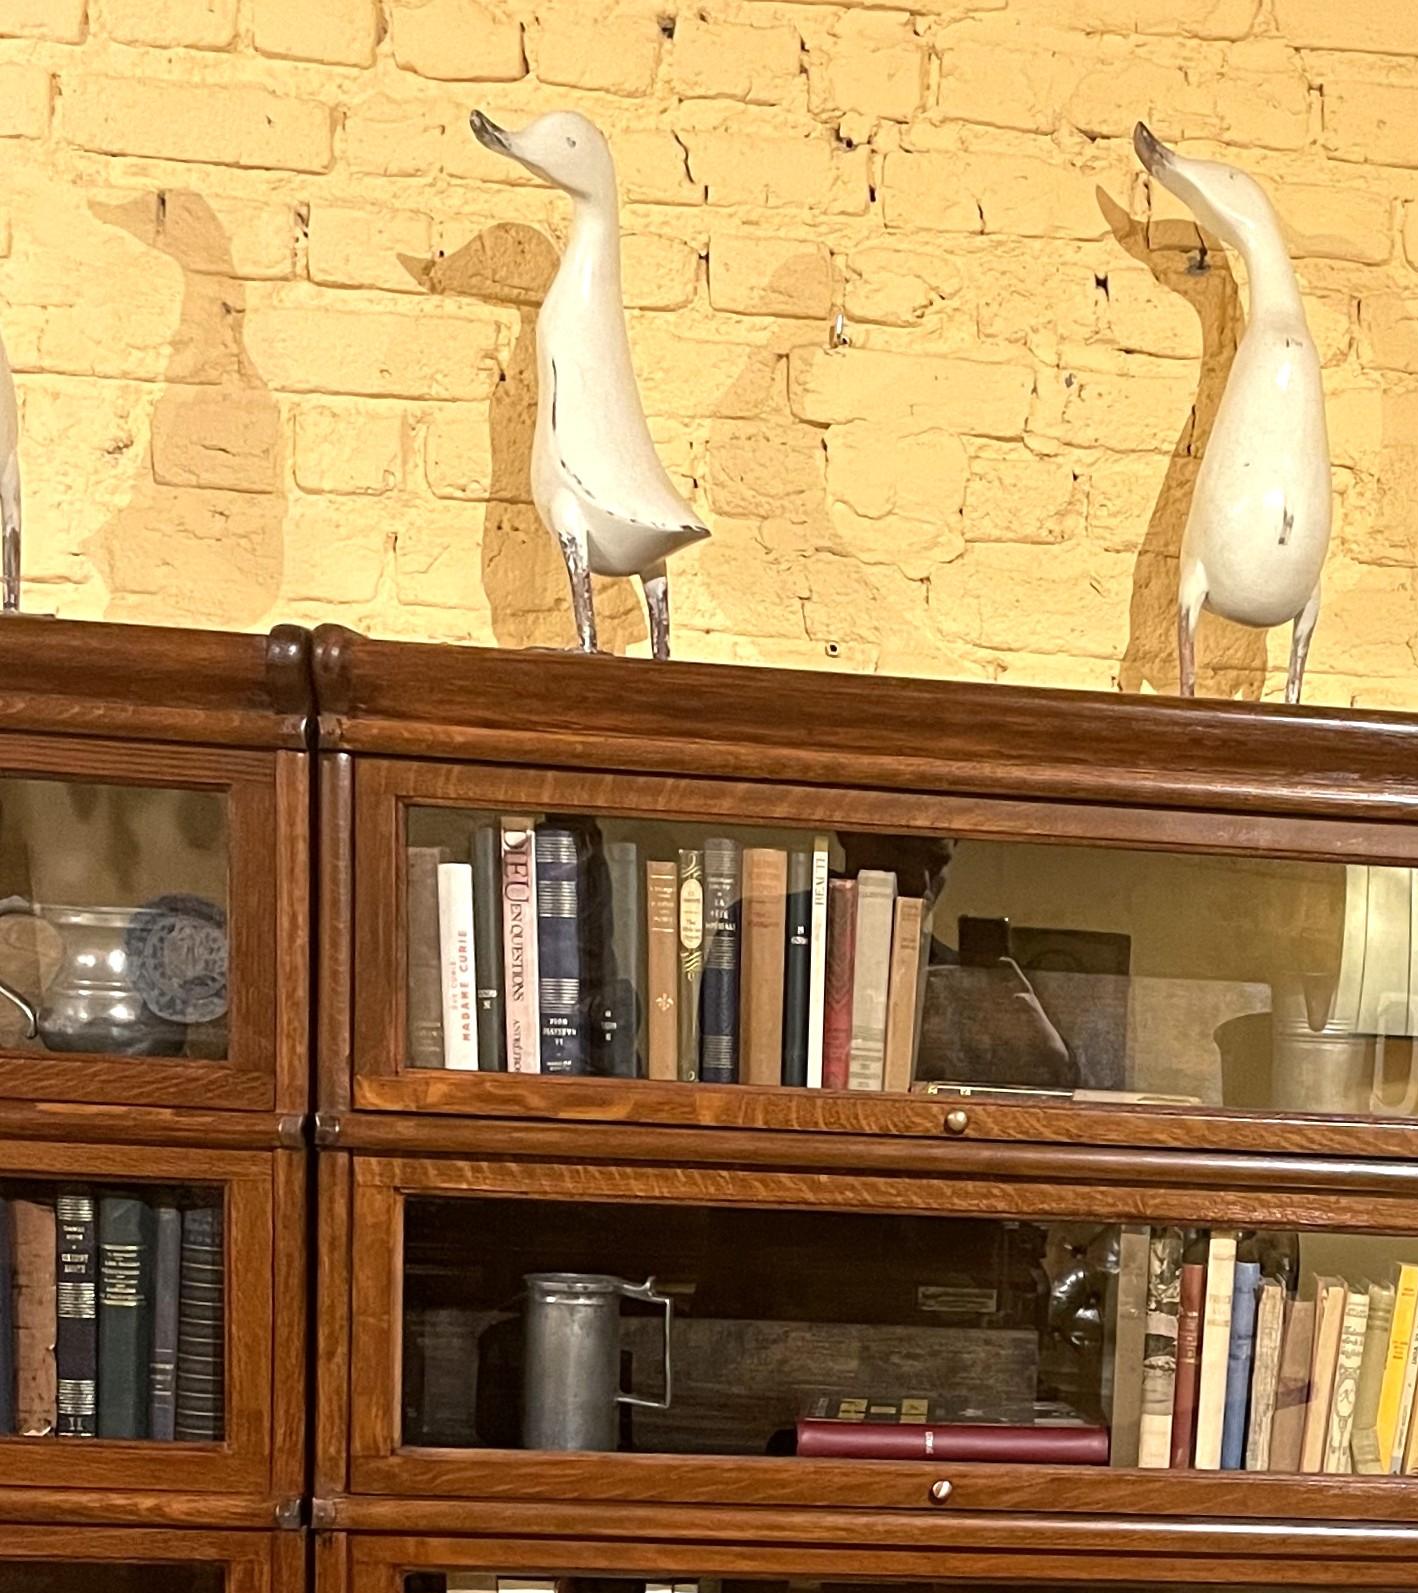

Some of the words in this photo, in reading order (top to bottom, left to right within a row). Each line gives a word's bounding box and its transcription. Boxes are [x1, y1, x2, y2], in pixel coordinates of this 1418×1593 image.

[503, 830, 529, 903] DIEU
[510, 904, 523, 923] EN
[457, 930, 469, 974] CURIE
[511, 925, 524, 1001] QUESTIONS
[459, 982, 472, 1041] MADAME
